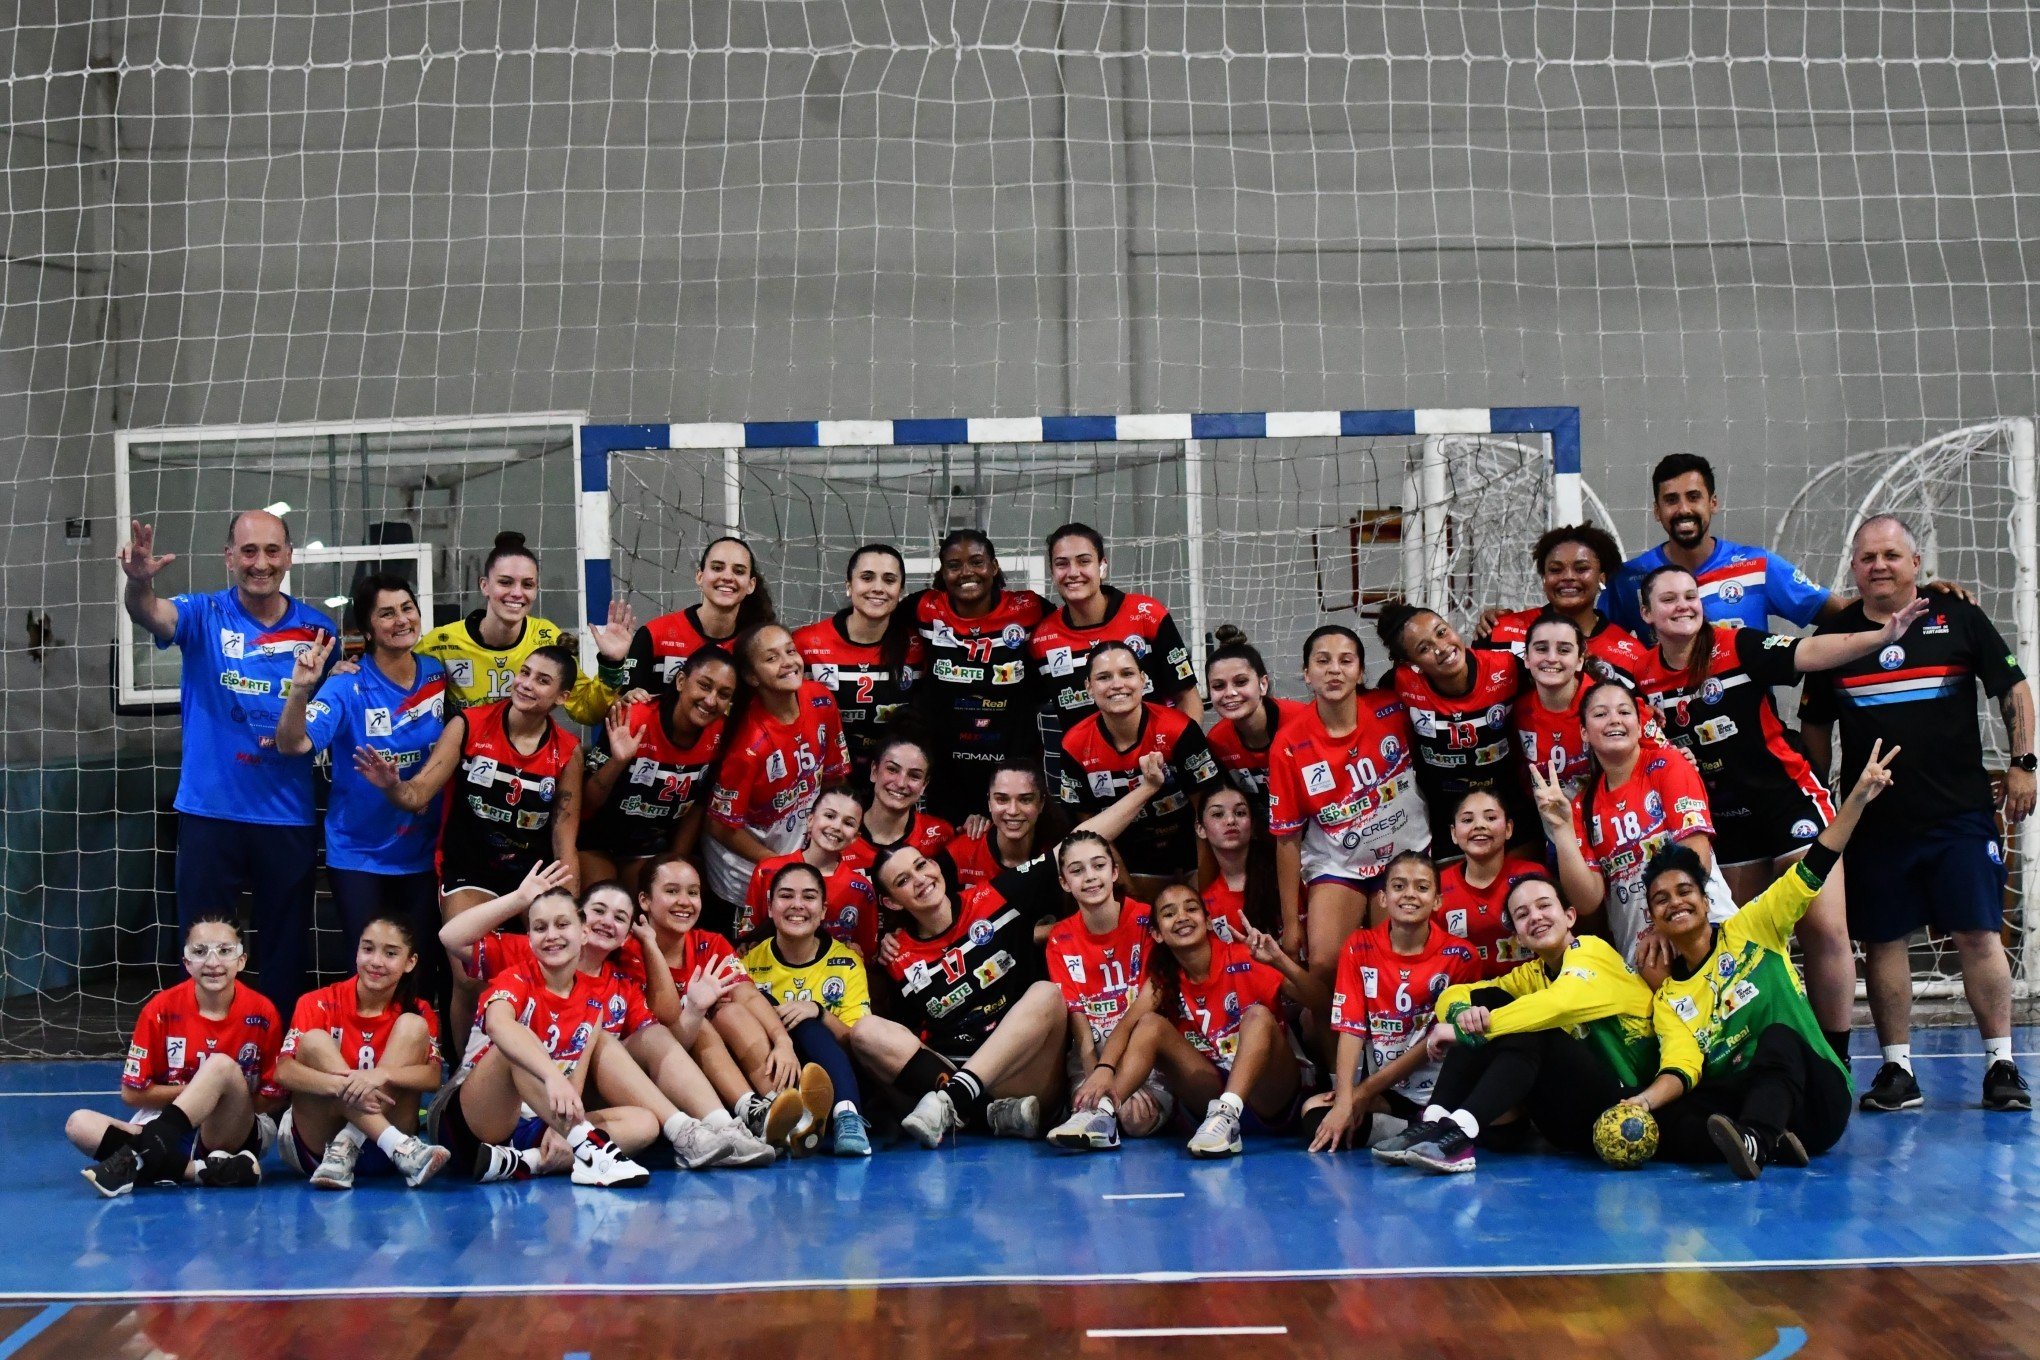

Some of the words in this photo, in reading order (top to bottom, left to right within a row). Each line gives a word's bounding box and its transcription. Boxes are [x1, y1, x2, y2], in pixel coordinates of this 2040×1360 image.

[963, 637, 993, 663] 77
[221, 675, 270, 692] ESPORTE
[487, 669, 515, 698] 12
[934, 666, 983, 680] ESPORTE
[1491, 670, 1506, 683] SC
[856, 675, 873, 703] 2
[982, 699, 1007, 708] Real
[1675, 700, 1691, 727] 6
[1448, 722, 1478, 750] 13
[793, 743, 816, 779] 15
[953, 752, 1006, 763] ROMANA
[1551, 745, 1566, 772] 9
[1703, 758, 1723, 772] Real
[658, 775, 691, 801] 24
[1345, 757, 1378, 793] 10
[505, 778, 523, 806] 3
[621, 801, 669, 816] ESPORTE
[1319, 798, 1369, 823] ESPORTE
[1323, 804, 1336, 815] pró
[926, 826, 940, 836] SC
[1361, 808, 1406, 837] CRESPI
[1611, 811, 1640, 846] 18
[1380, 845, 1392, 854] MF
[940, 947, 966, 985] 17
[1100, 961, 1128, 993] 11
[984, 995, 1006, 1015] Real
[1395, 982, 1412, 1013] 6
[1196, 1010, 1212, 1037] 7
[1726, 1025, 1749, 1047] Real
[543, 1024, 560, 1053] 3
[359, 1046, 375, 1070] 8
